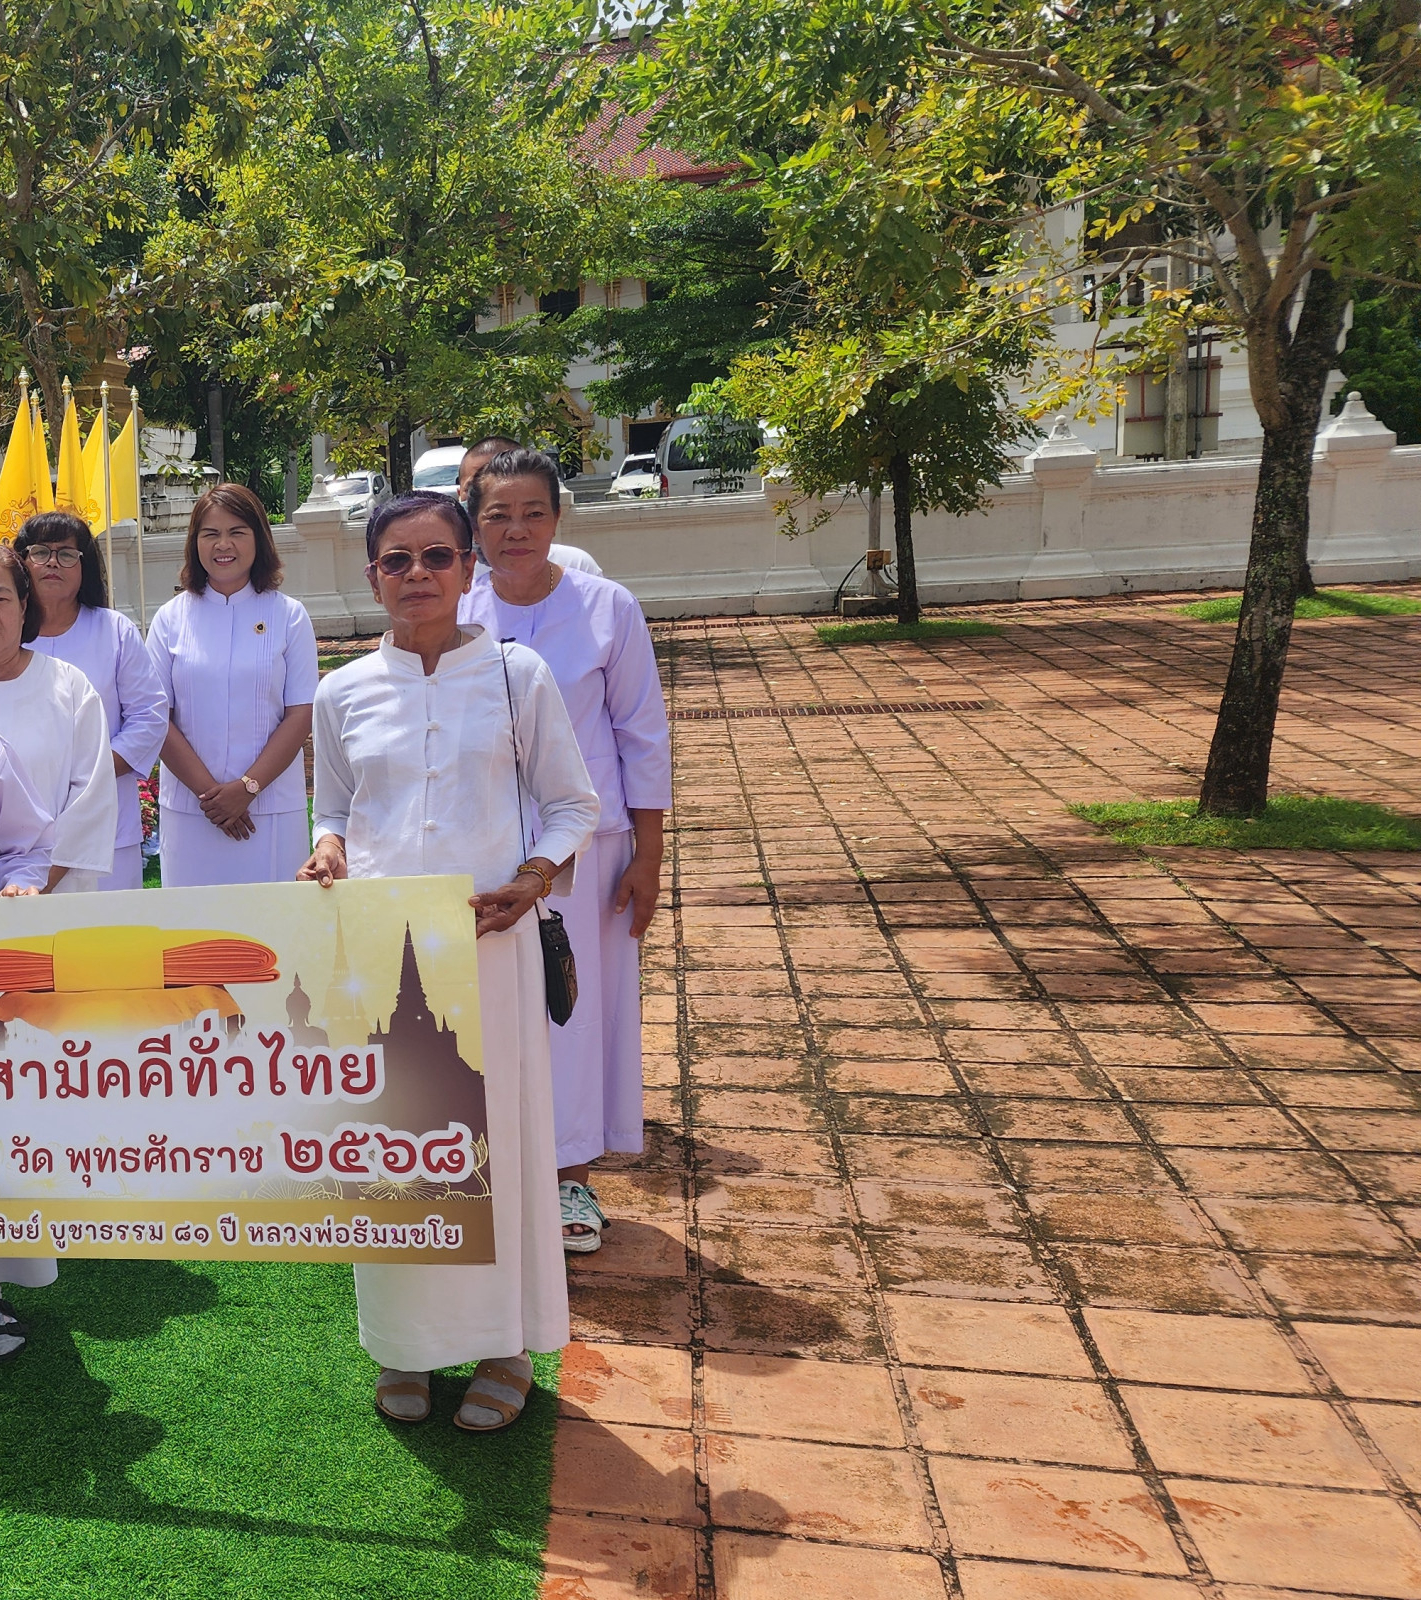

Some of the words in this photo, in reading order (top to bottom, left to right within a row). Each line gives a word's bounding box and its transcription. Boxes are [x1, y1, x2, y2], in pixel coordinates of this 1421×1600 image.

[9, 1135, 54, 1174] วัด
[65, 1133, 264, 1189] พุทธศักราช
[279, 1129, 467, 1175] ๒๕๖๘
[49, 1222, 164, 1249] บูชาธรรม
[174, 1222, 210, 1244] ๘๑
[220, 1214, 237, 1242] ปี
[248, 1218, 460, 1246] หลวงพ่อธัมมชโย
